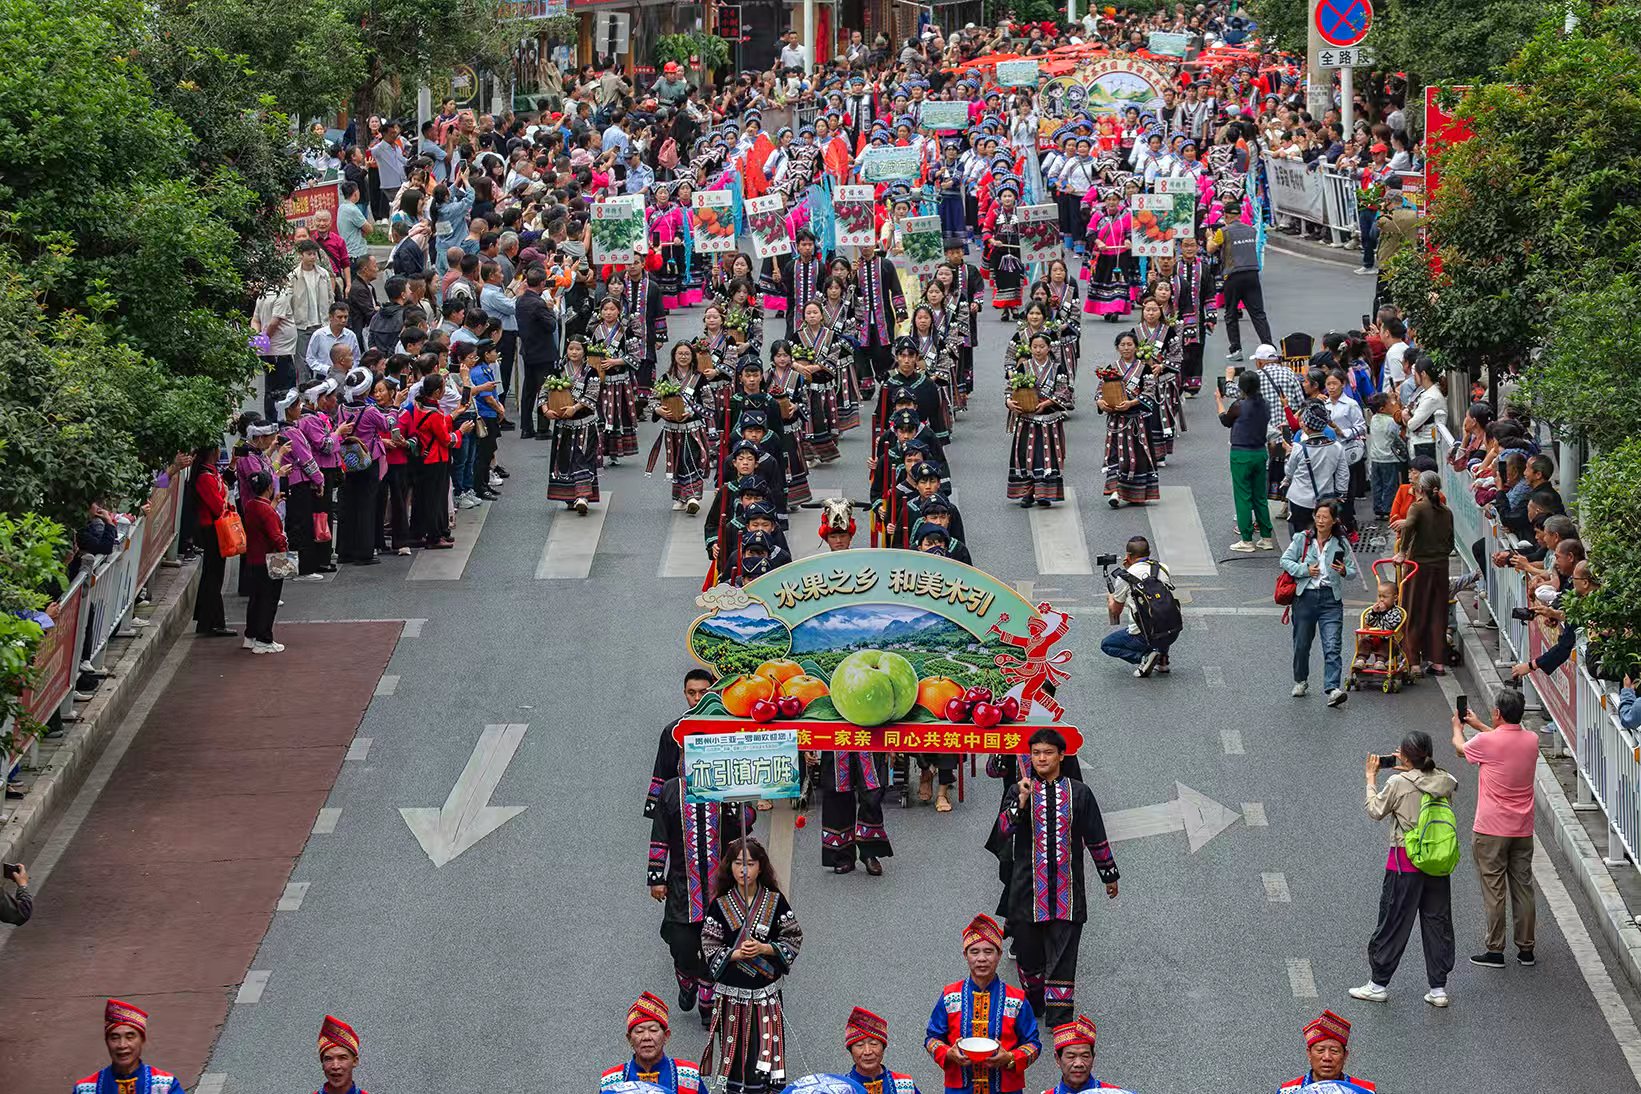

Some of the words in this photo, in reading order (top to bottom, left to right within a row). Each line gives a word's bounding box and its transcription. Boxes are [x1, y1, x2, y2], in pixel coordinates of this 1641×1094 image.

[775, 567, 879, 609] 水果之乡
[889, 568, 996, 617] 和美木引
[884, 730, 1022, 750] 同心共筑中国梦
[692, 755, 794, 787] 木引镇方阵
